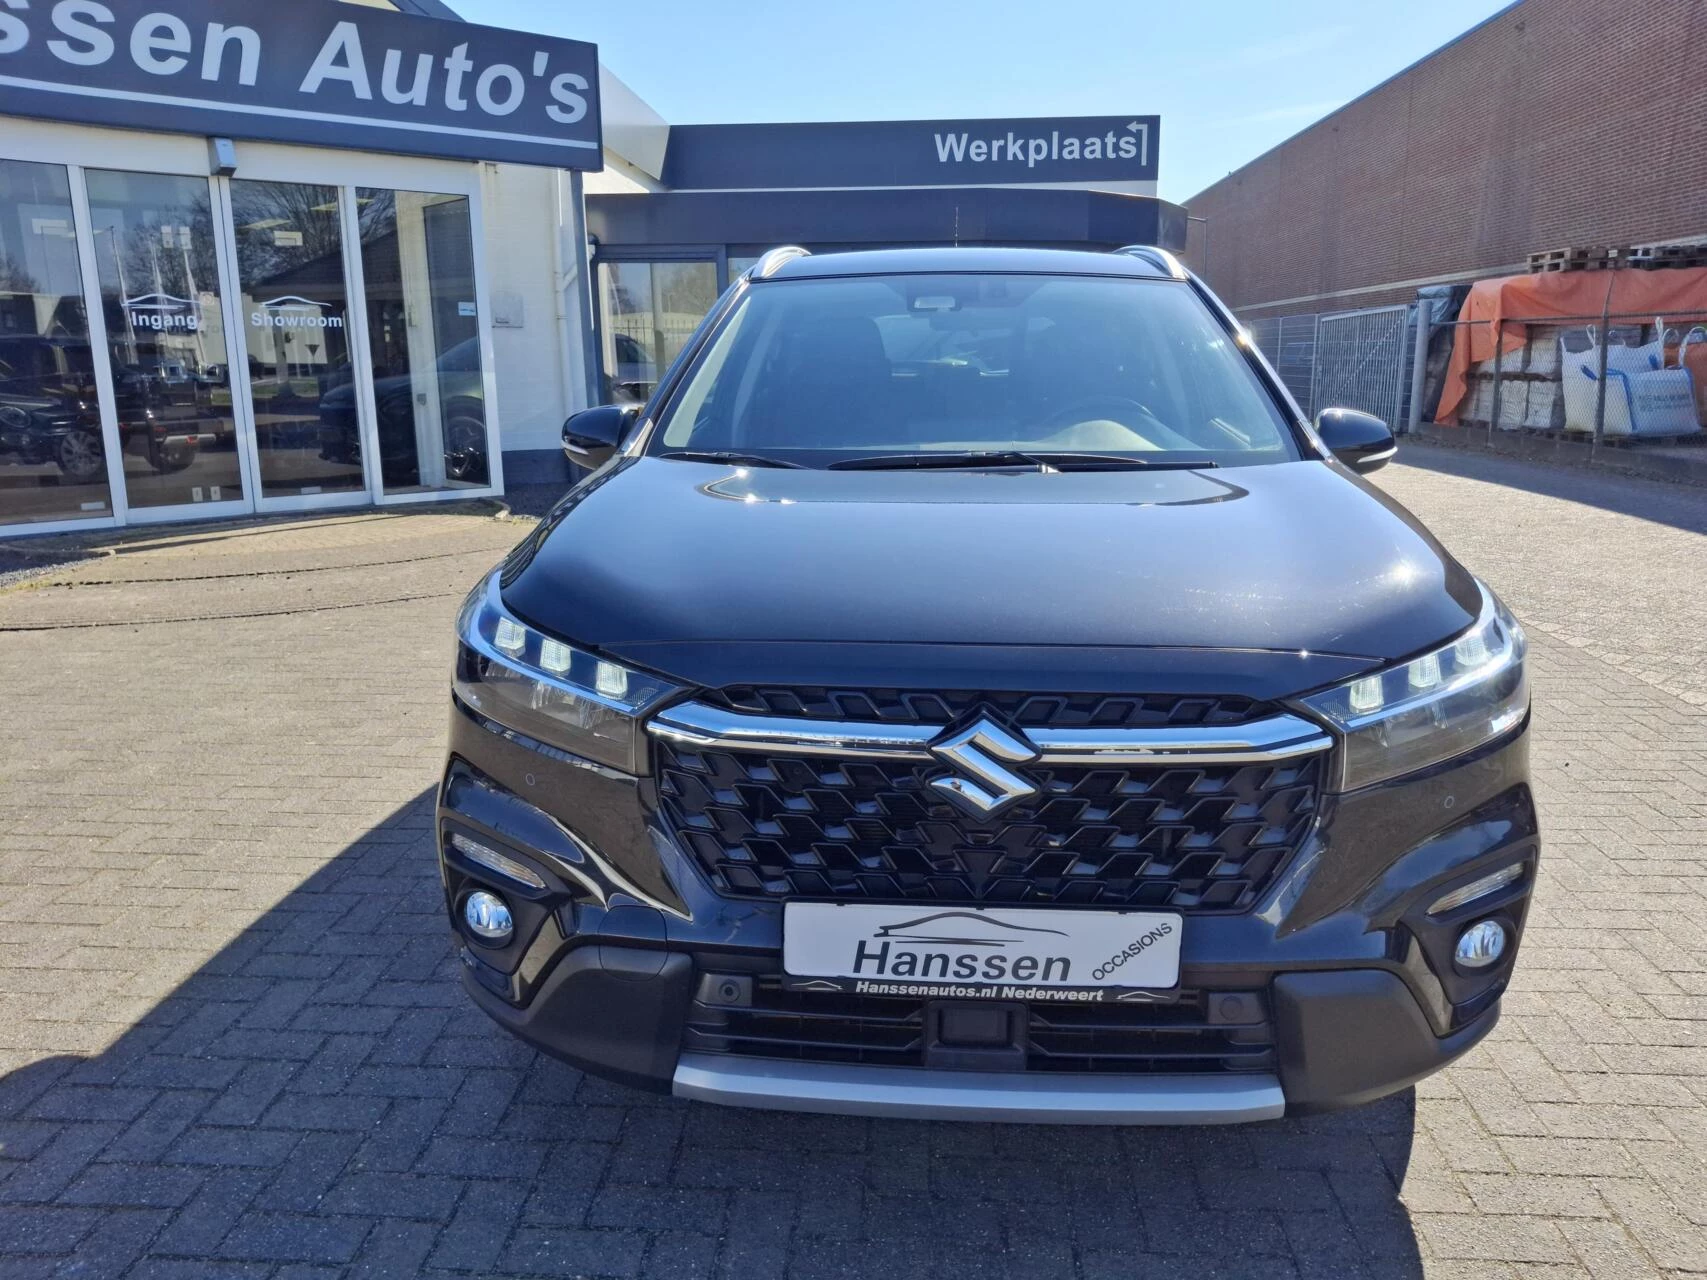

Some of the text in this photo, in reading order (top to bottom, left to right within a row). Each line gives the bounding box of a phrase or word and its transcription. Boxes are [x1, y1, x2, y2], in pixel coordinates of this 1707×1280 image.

[299, 21, 589, 124] Auto's
[934, 130, 1137, 168] Werkplaats
[131, 311, 198, 330] Ingang
[251, 312, 343, 328] Showroom
[853, 940, 1071, 982] Hanssen
[1091, 922, 1173, 982] OCCASIONS
[855, 981, 1104, 1001] Hanssenautos.nl Nederweert
